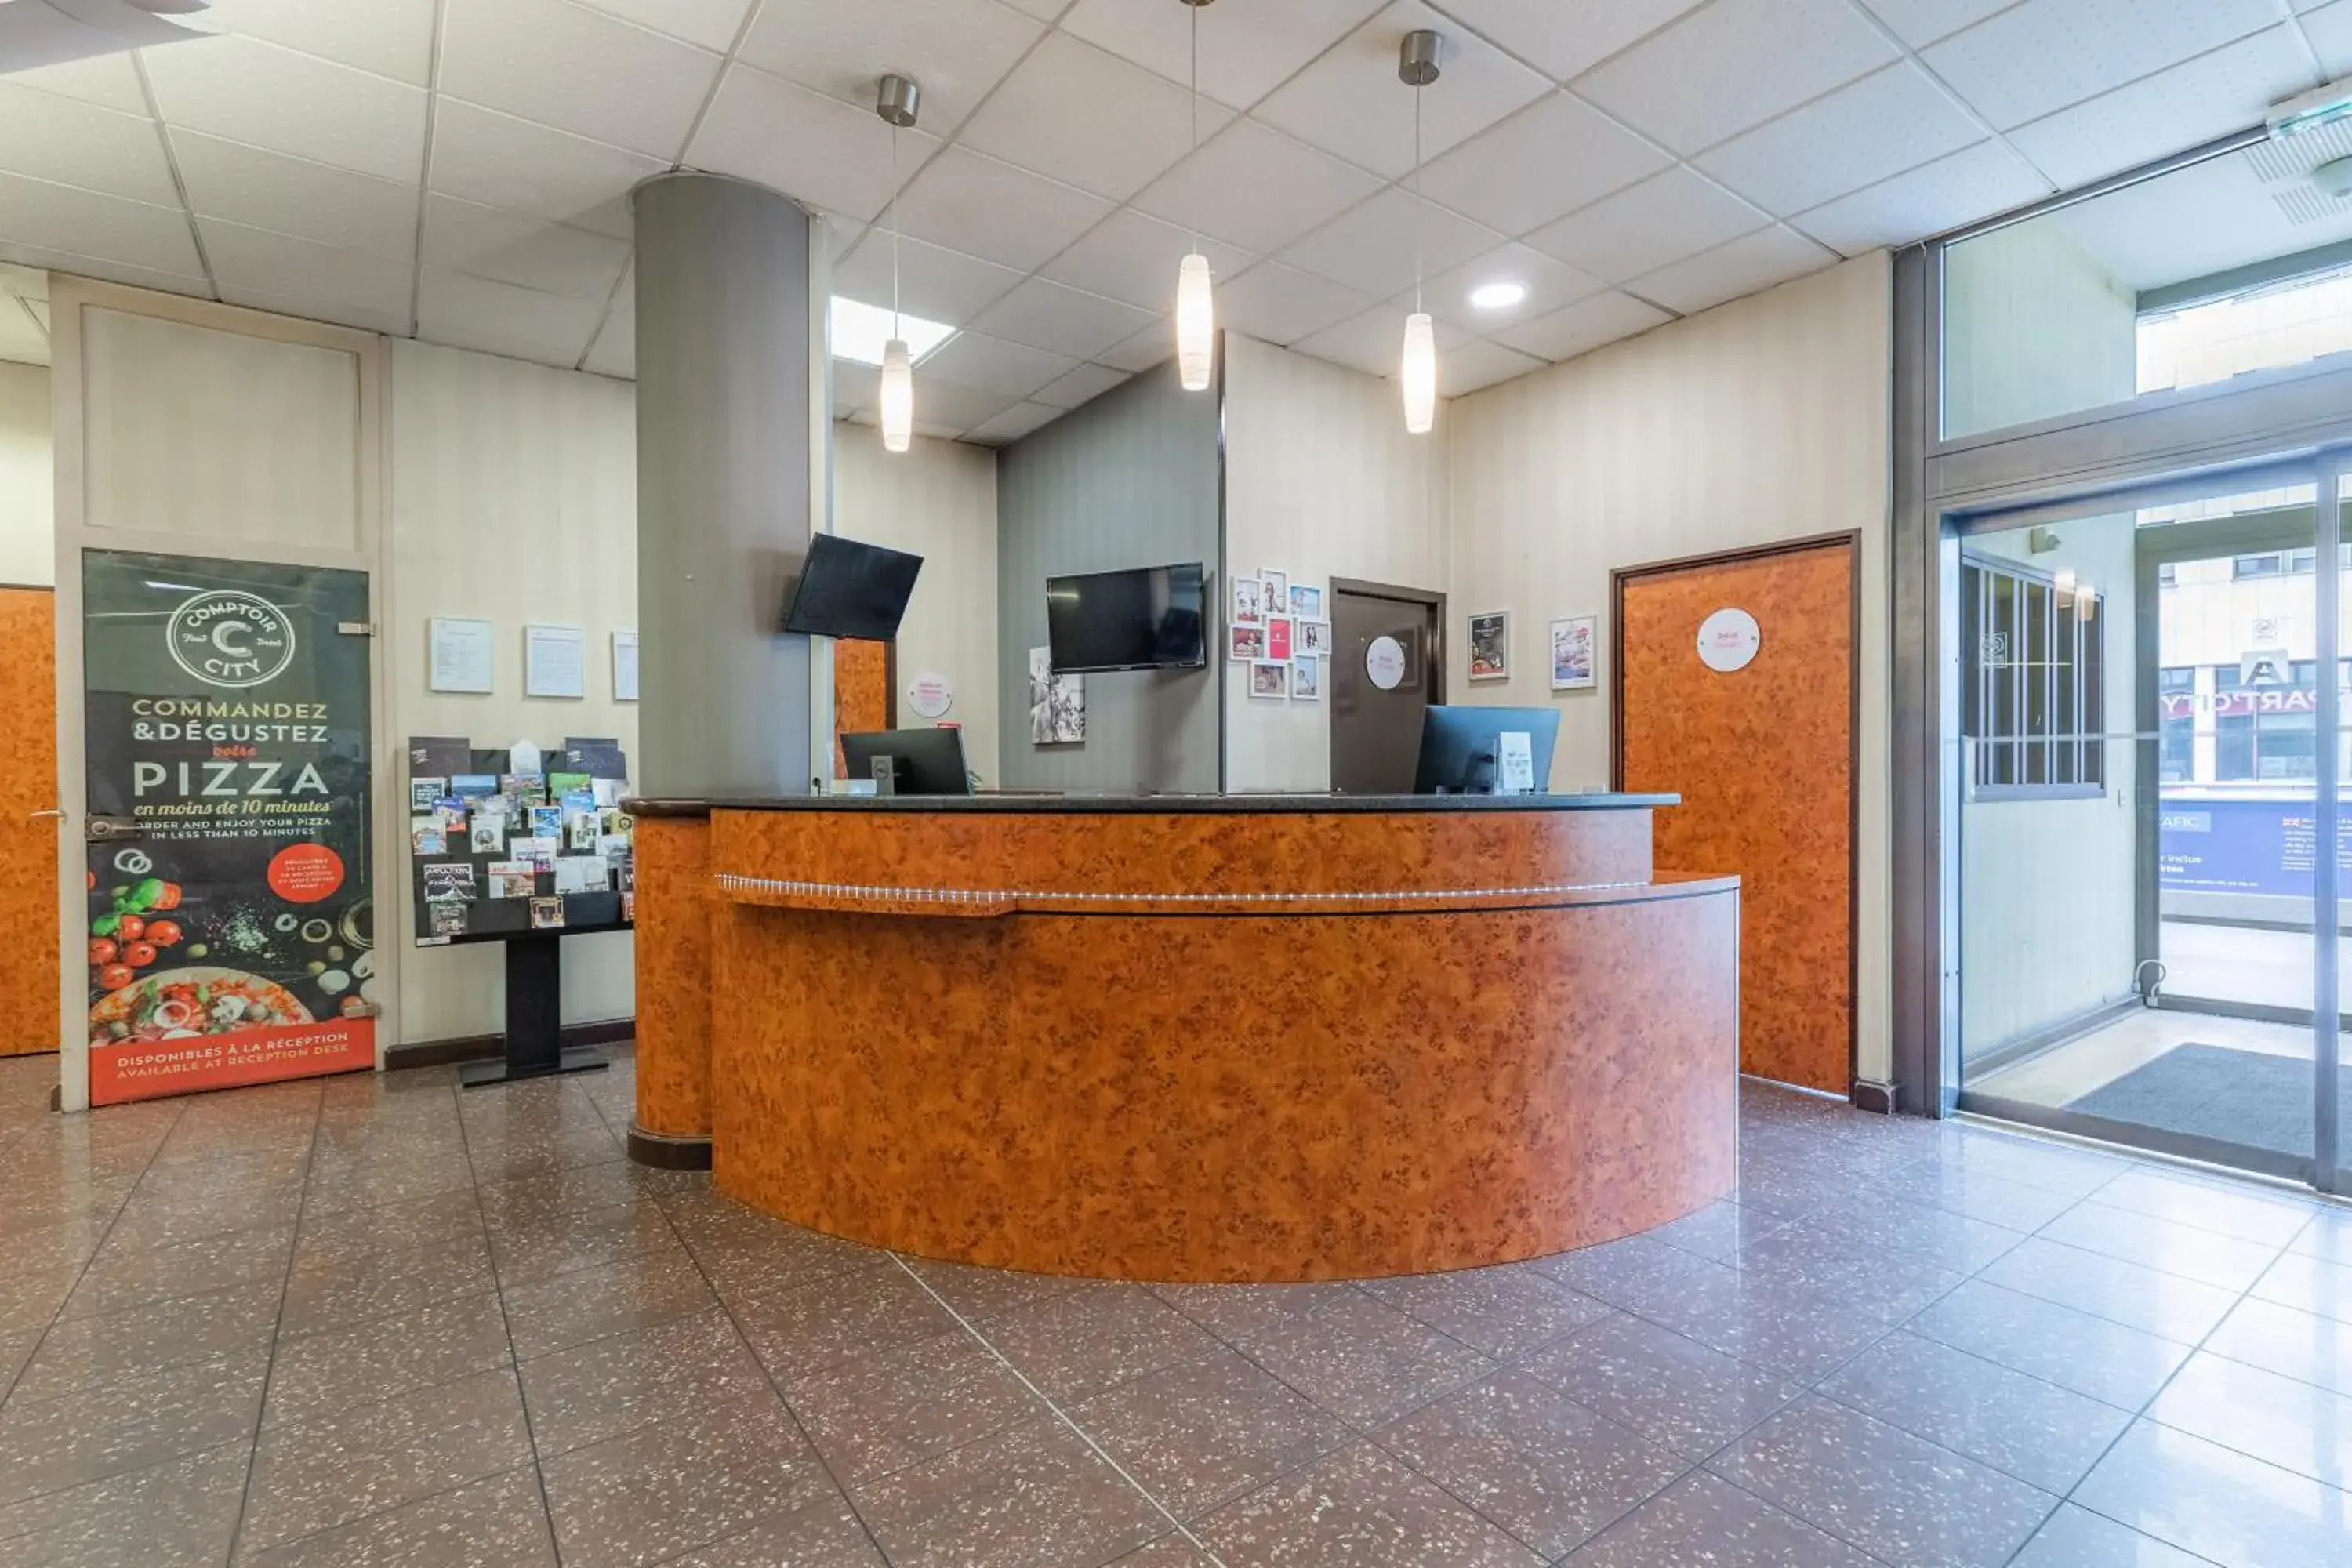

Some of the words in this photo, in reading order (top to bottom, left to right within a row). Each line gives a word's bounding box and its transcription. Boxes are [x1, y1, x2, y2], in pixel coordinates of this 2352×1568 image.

[187, 601, 278, 633] COMPTOIR
[212, 620, 253, 658] C
[204, 658, 261, 677] CITY
[132, 699, 328, 719] COMMANDEZ
[133, 761, 330, 797] PIZZA
[134, 805, 154, 816] en
[158, 800, 213, 815] moins
[216, 800, 238, 815] de
[241, 799, 262, 813] 10
[216, 819, 255, 828] ENJOY
[263, 827, 314, 836] MINUTES
[117, 1047, 222, 1067] DISPONIBLES
[243, 1044, 261, 1053] LA
[117, 1062, 199, 1079] AVAILABLE
[205, 1058, 221, 1069] AT
[227, 1049, 309, 1066] RECEPTION
[314, 1044, 348, 1055] DESK
